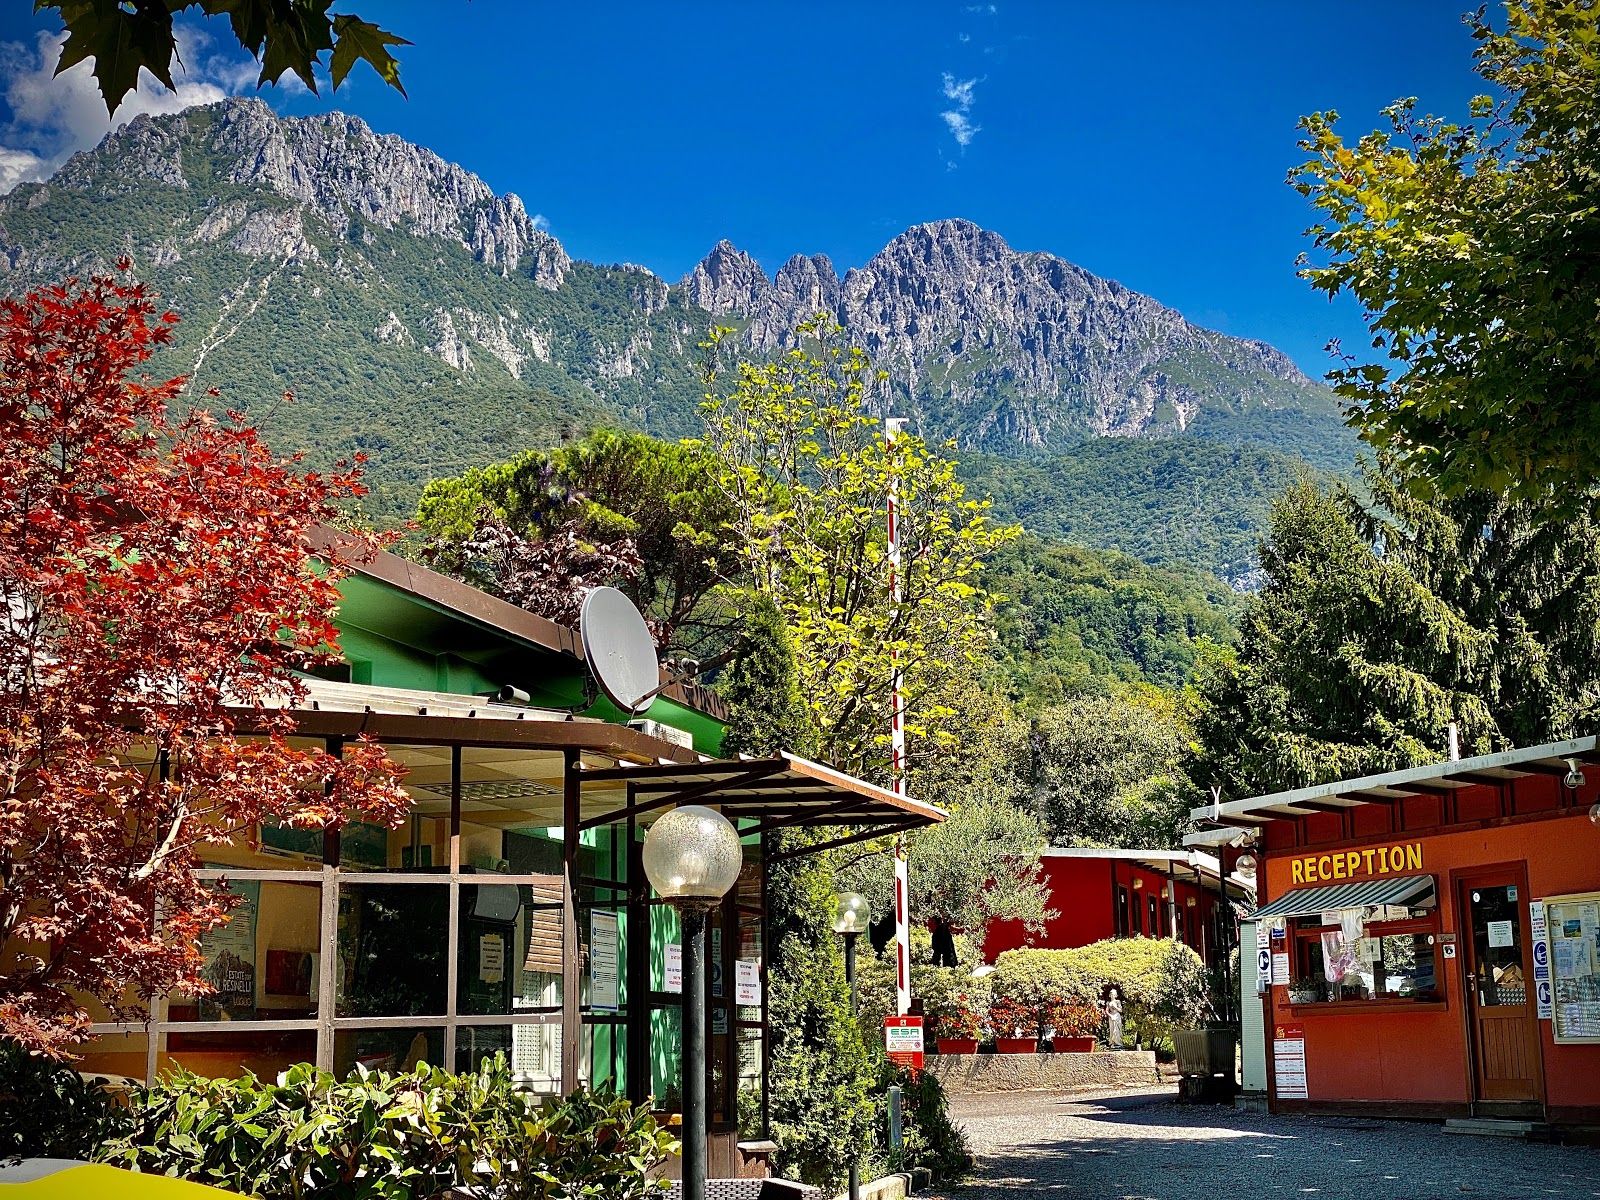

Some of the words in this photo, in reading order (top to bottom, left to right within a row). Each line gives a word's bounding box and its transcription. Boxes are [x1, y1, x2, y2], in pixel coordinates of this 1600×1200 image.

[1291, 843, 1423, 885] RECEPTION
[228, 970, 245, 980] ESTATE
[890, 1028, 919, 1036] ESA
